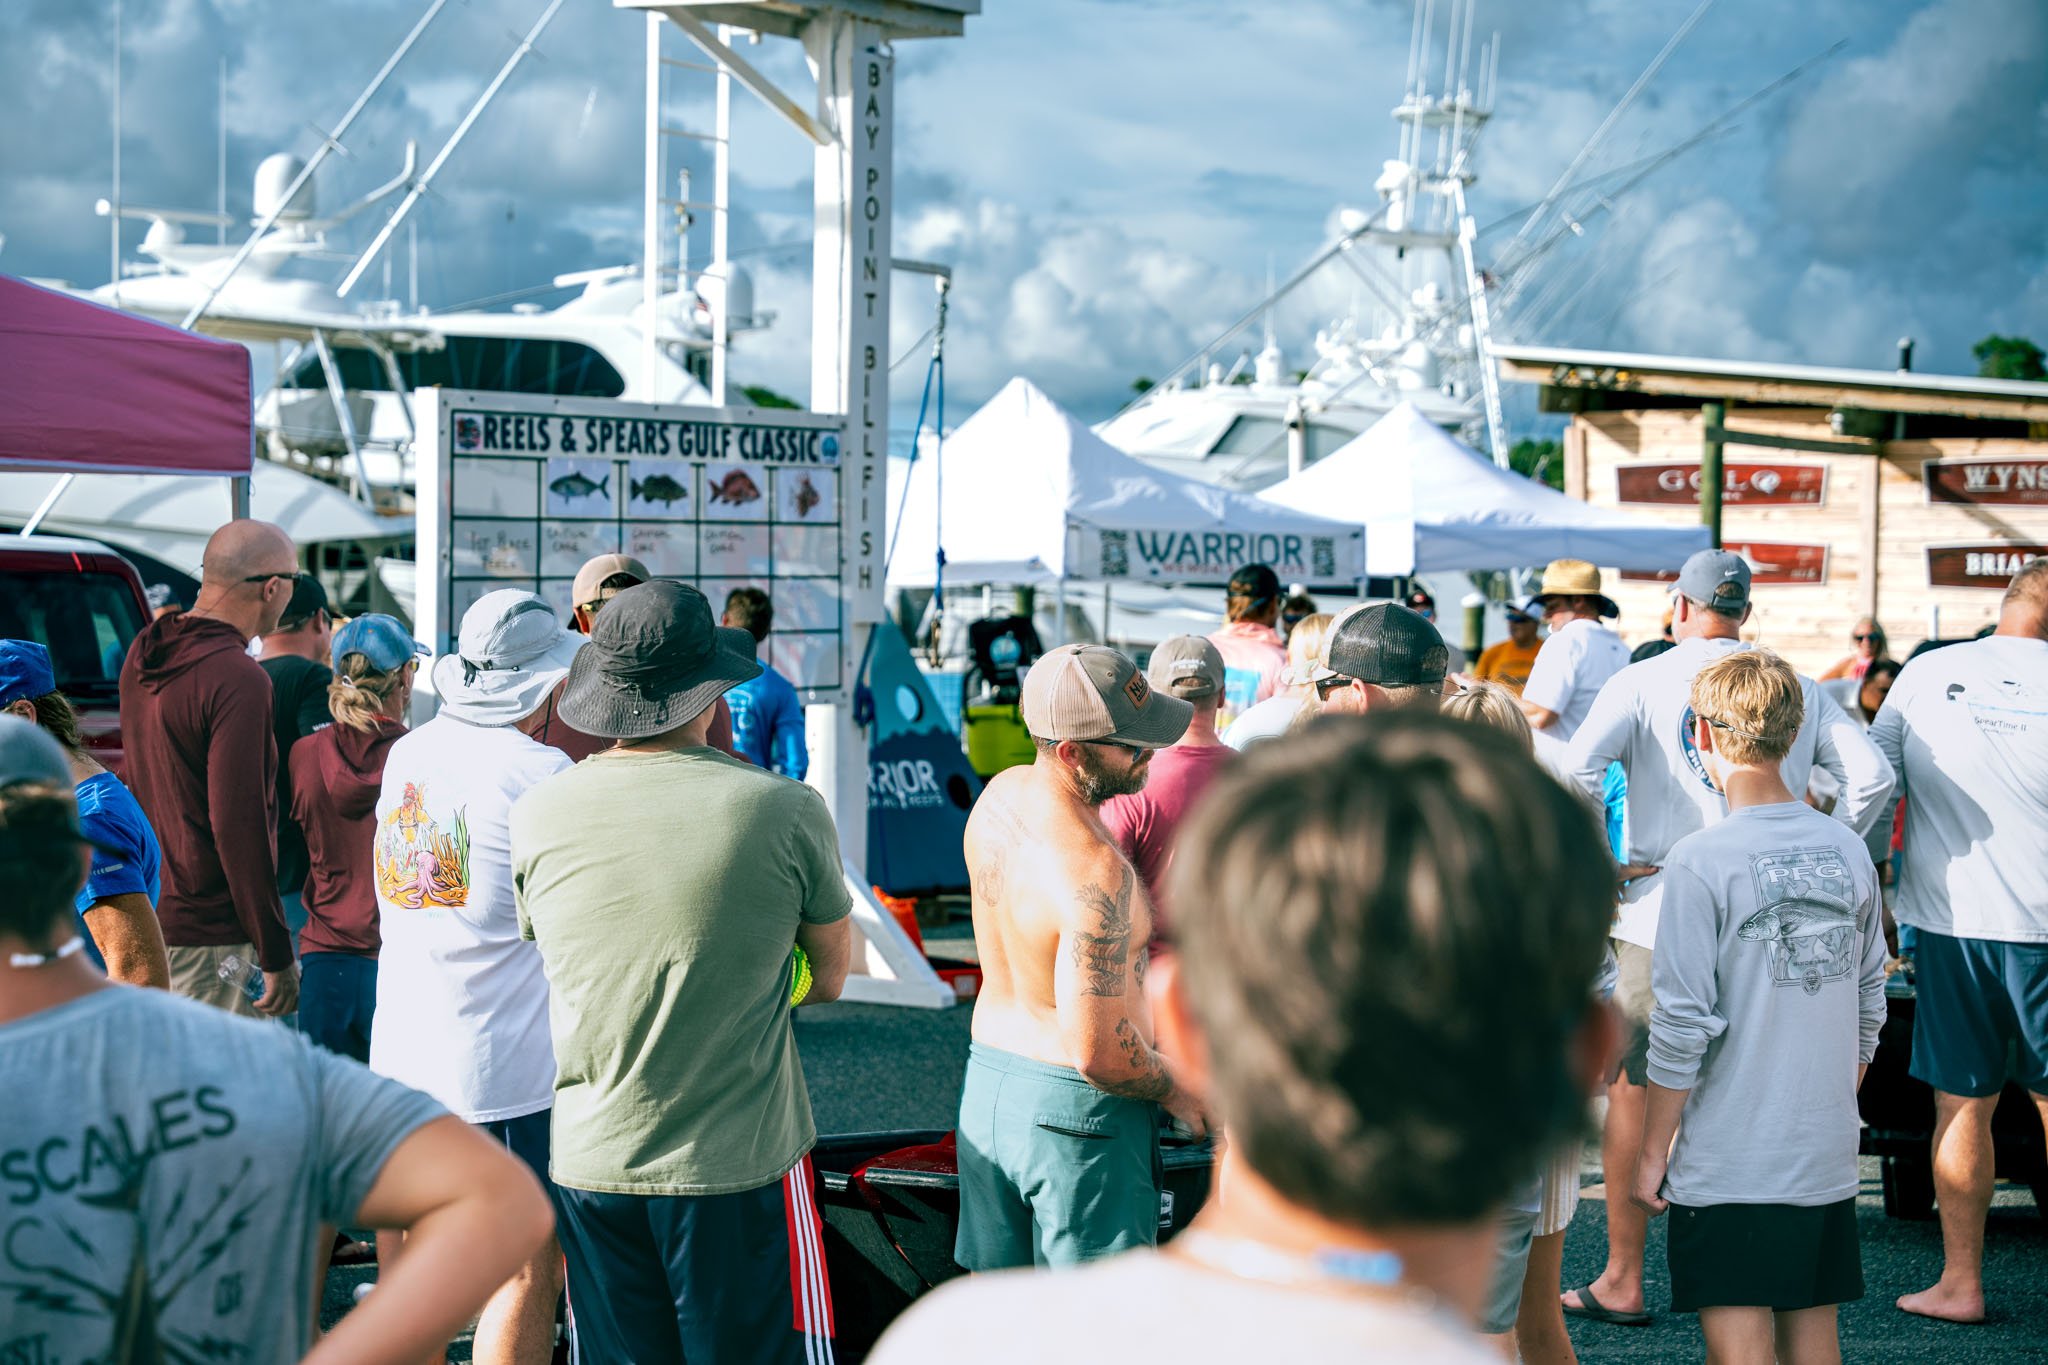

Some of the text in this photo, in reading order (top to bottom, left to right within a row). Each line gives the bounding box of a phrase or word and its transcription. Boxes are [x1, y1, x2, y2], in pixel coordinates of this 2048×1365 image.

[858, 62, 881, 590] BAY POINT BILLFISH
[483, 415, 820, 463] REELS & SPEARS GULF CLASSIC
[1135, 530, 1303, 567] WARRIOR
[866, 760, 939, 793] RRIOR
[1766, 863, 1843, 883] PFG
[0, 1085, 237, 1206] SCALES
